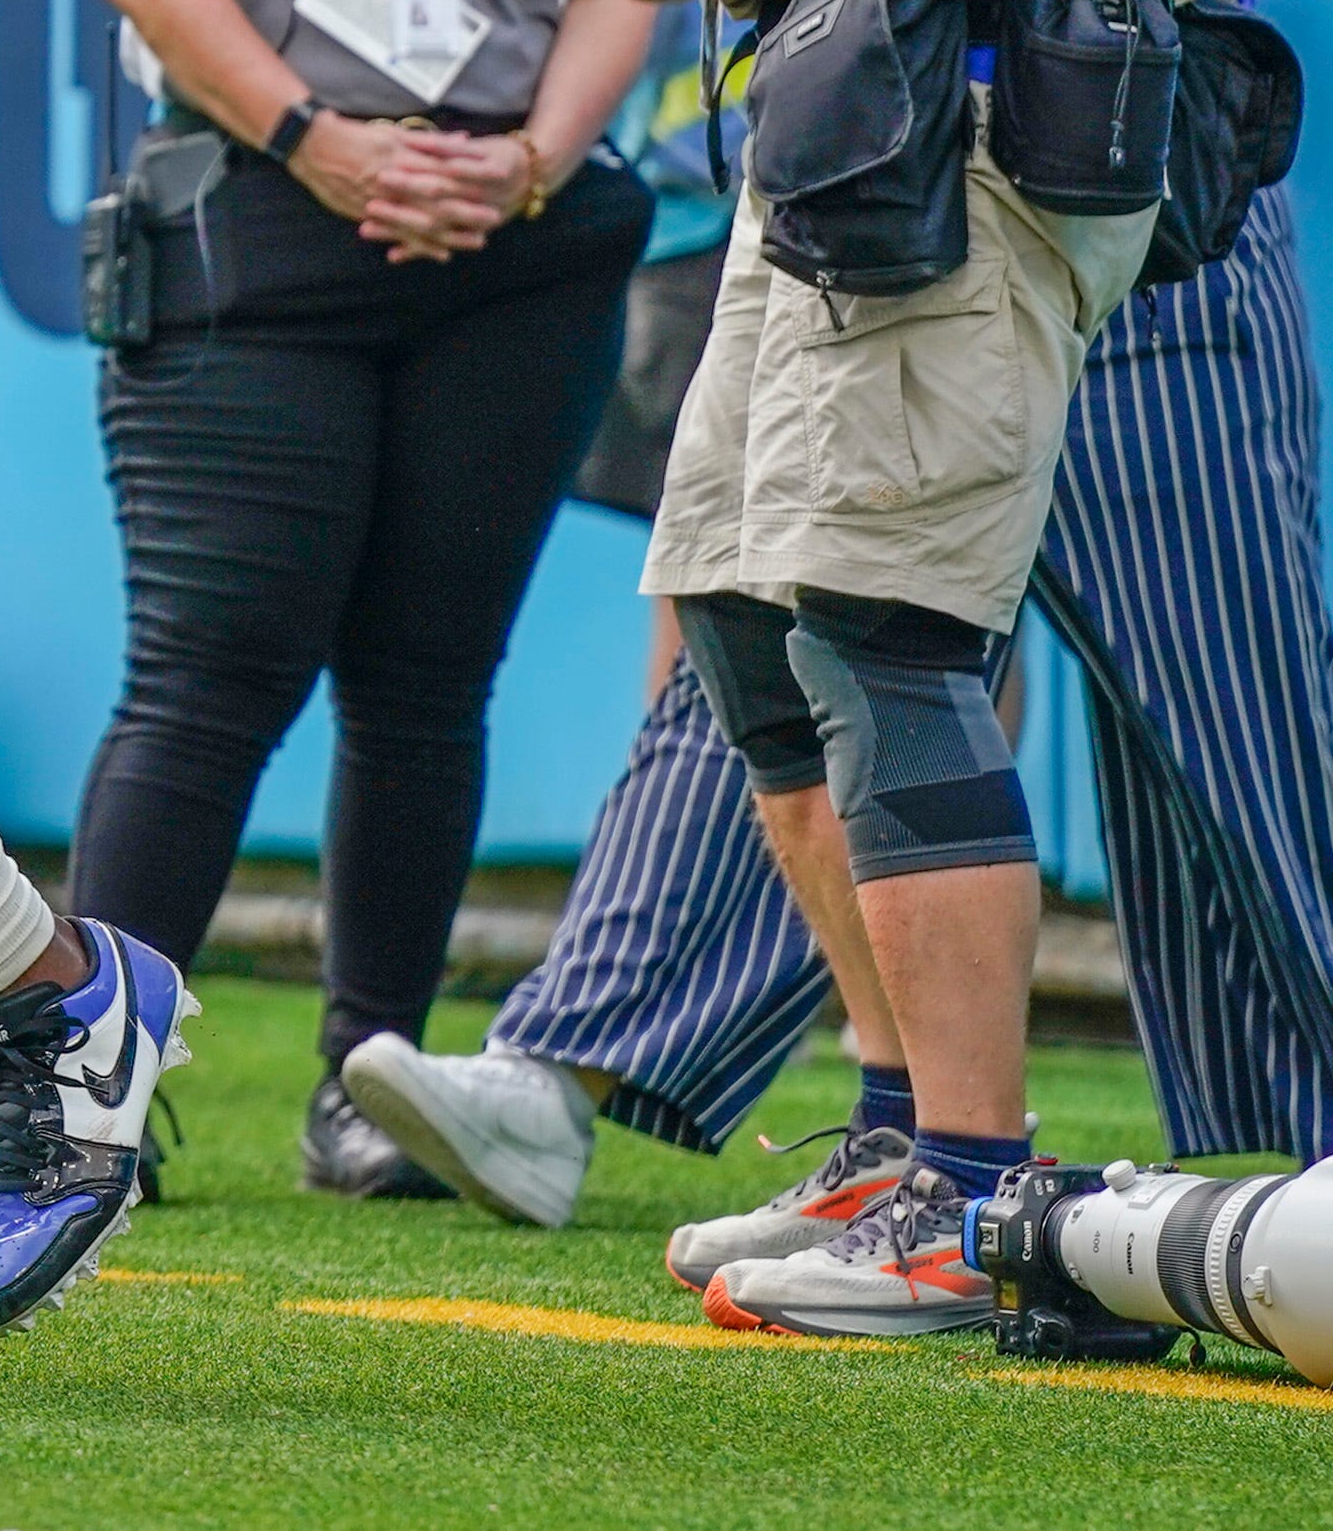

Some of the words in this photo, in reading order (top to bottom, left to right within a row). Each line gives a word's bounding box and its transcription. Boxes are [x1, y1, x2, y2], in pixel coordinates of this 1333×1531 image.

[1022, 1221, 1032, 1261] Canon
[1093, 1231, 1101, 1253] 400
[1127, 1232, 1135, 1275] Canon
